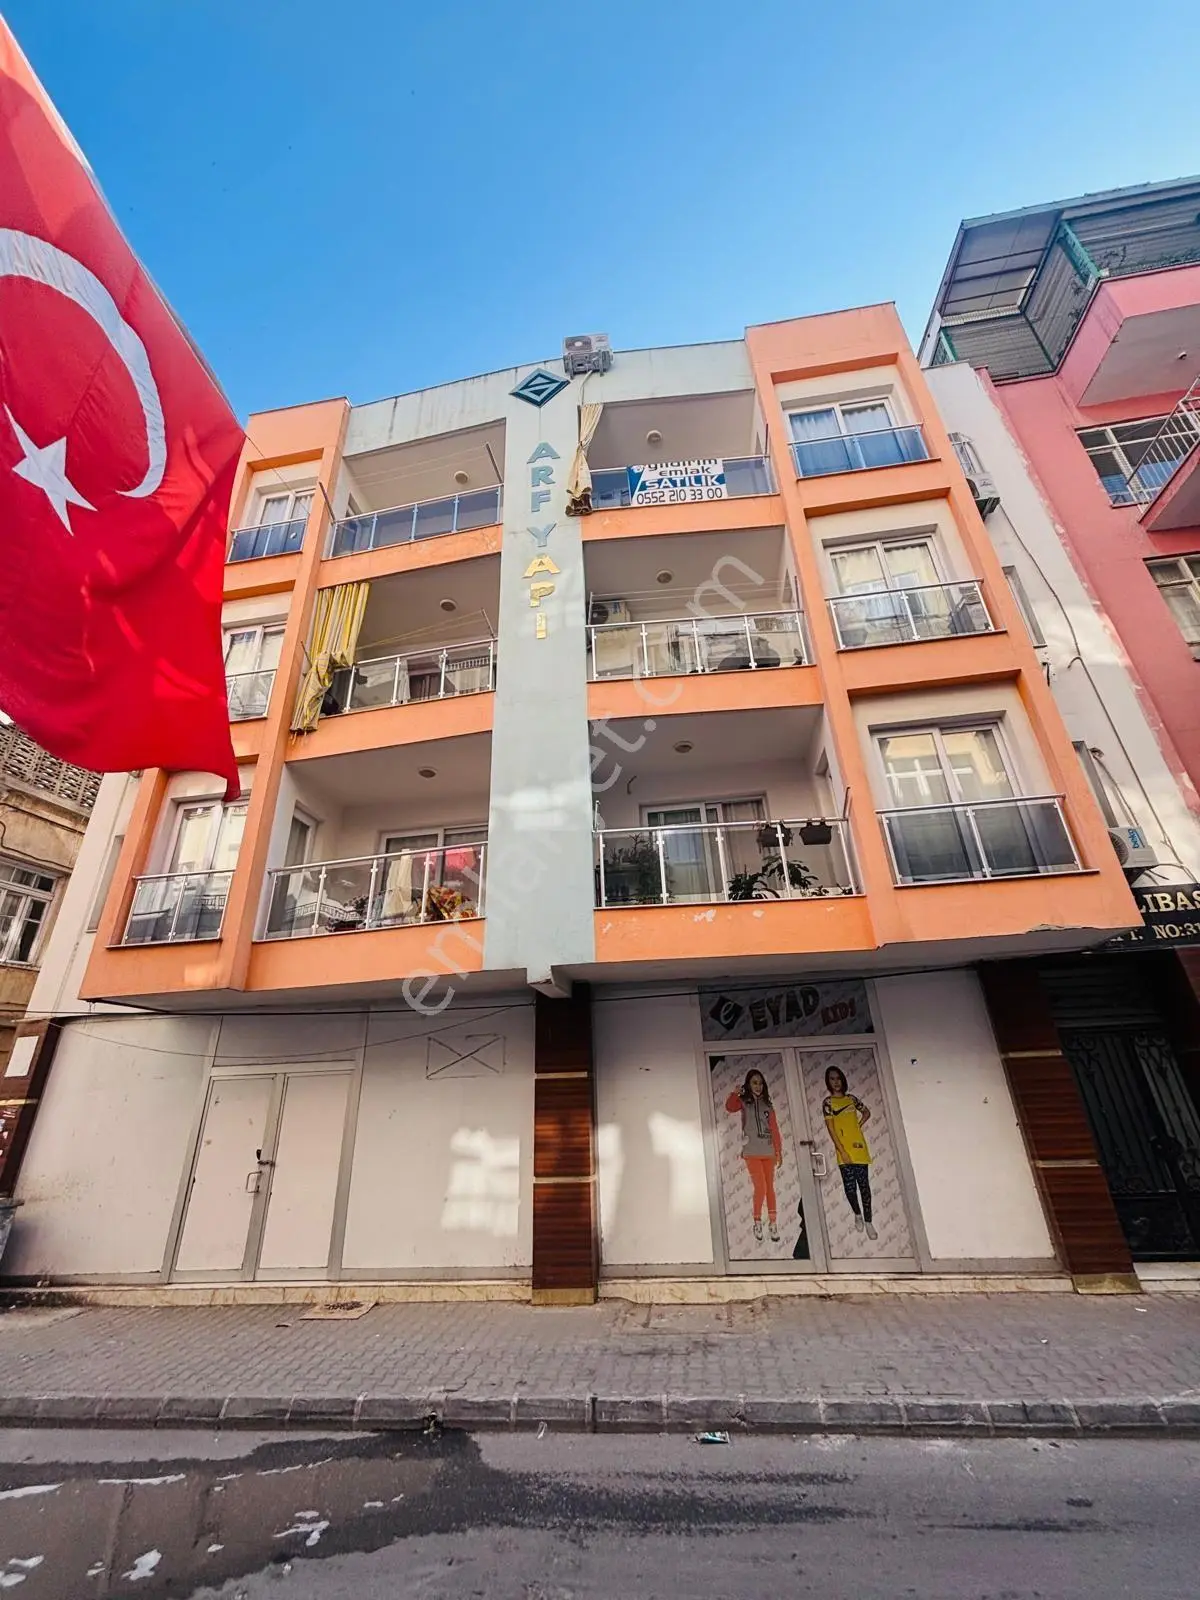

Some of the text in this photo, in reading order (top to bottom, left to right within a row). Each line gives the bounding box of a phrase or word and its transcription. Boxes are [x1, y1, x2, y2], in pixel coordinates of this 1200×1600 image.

[659, 466, 711, 477] emlak
[645, 475, 720, 490] SATILIK
[636, 487, 723, 505] 0552 210 33 00
[749, 986, 821, 1032] EYAD
